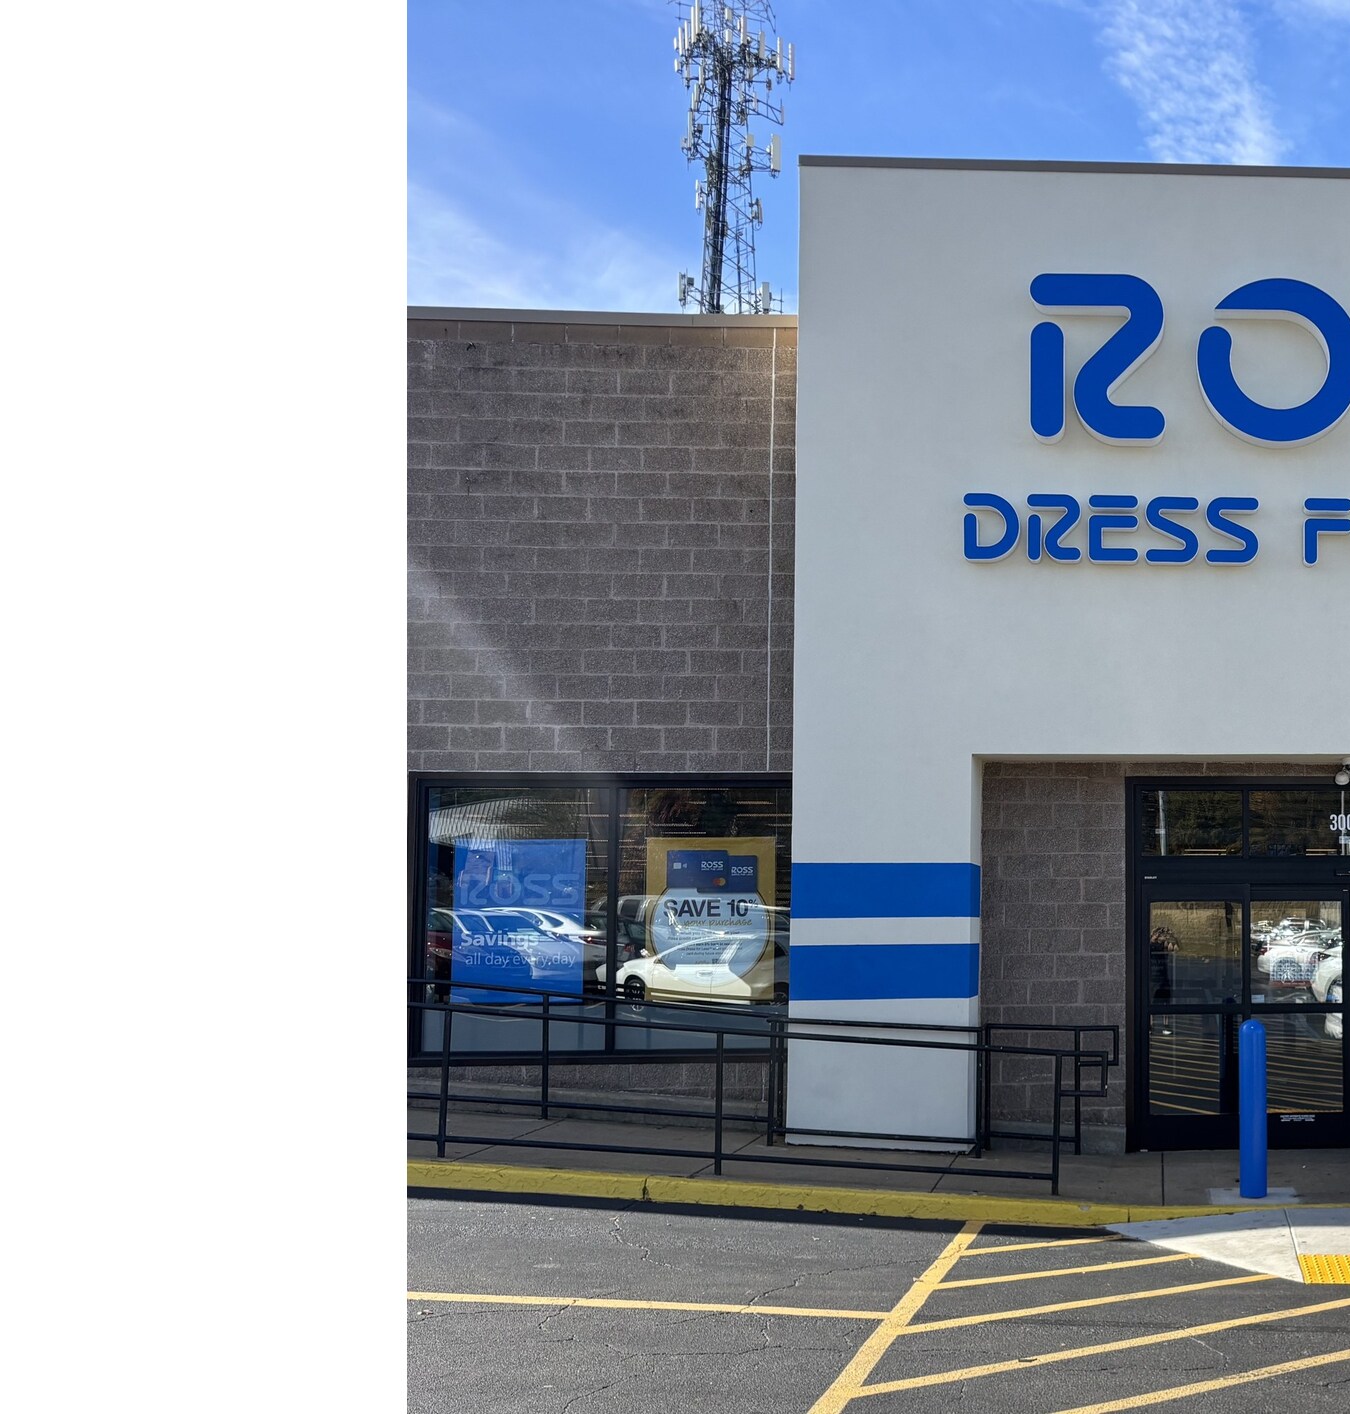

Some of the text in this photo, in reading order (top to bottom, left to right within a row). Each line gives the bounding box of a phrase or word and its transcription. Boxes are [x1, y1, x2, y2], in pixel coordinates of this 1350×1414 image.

[964, 494, 1258, 562] DRESS
[460, 873, 579, 905] ROSS
[663, 899, 721, 917] SAVE
[708, 918, 752, 927] purchase
[460, 930, 539, 950] Savings
[465, 952, 576, 968] all day every day
